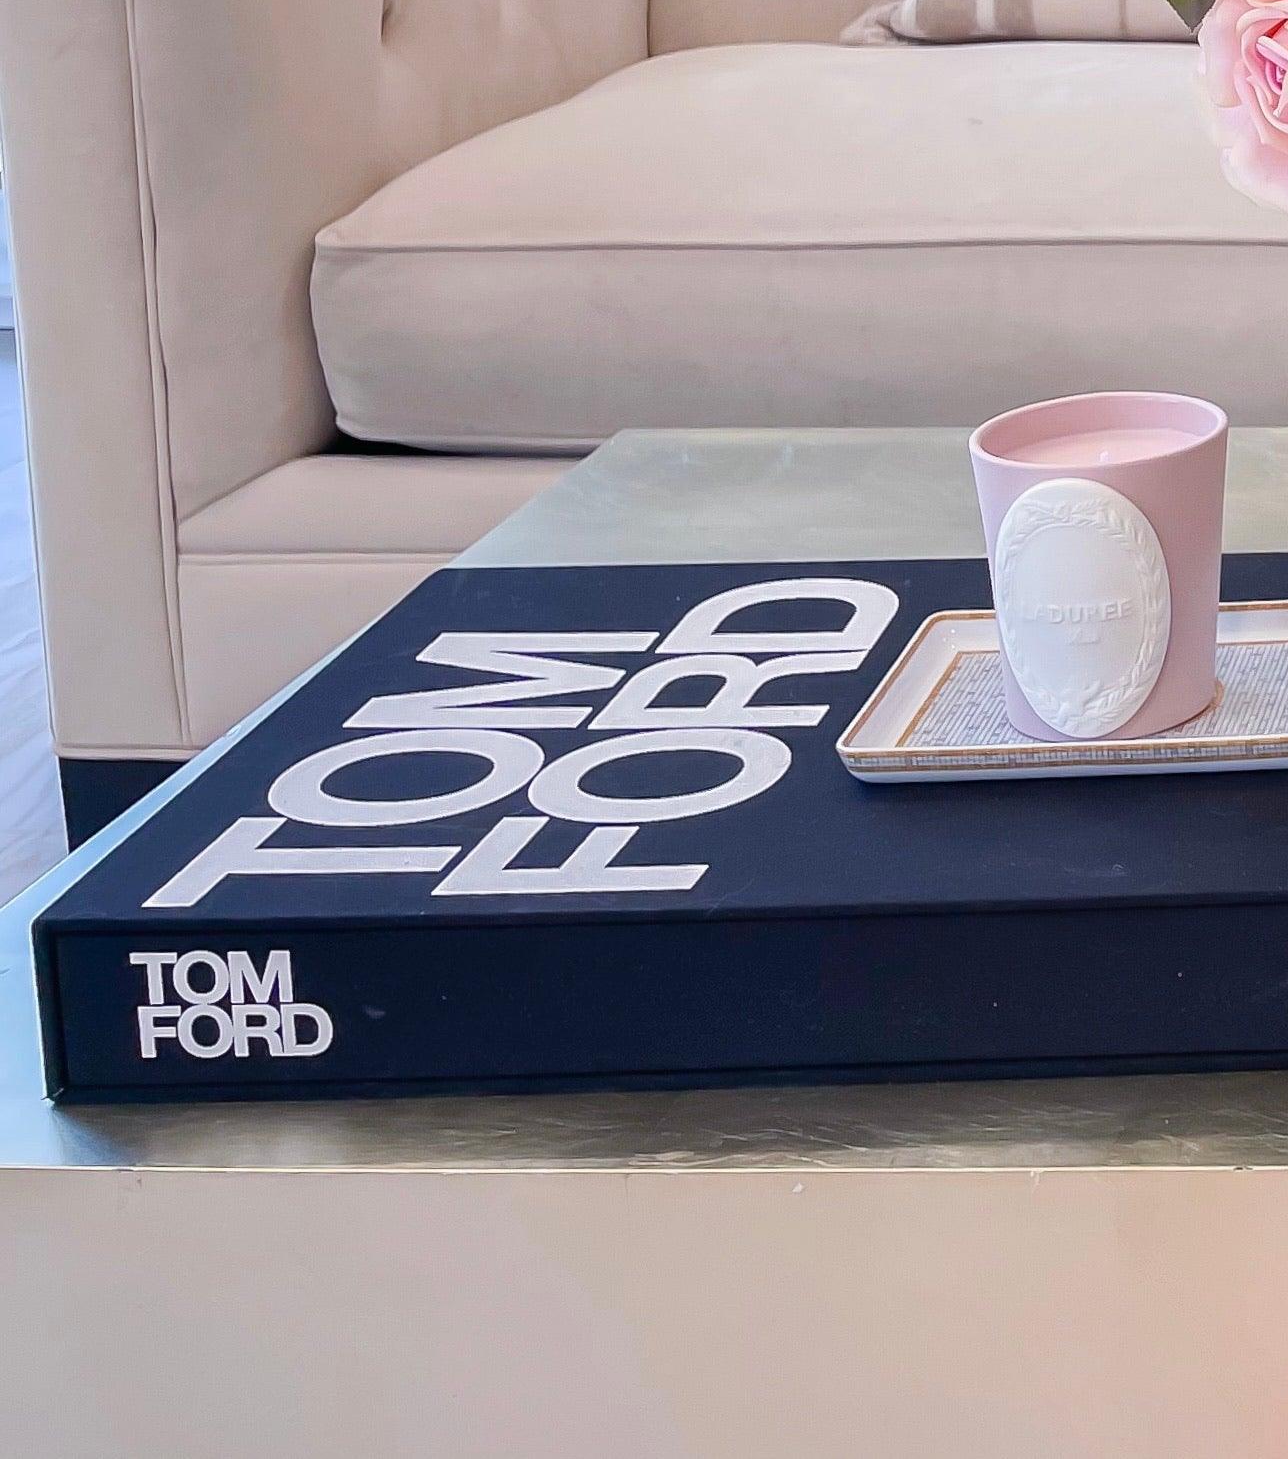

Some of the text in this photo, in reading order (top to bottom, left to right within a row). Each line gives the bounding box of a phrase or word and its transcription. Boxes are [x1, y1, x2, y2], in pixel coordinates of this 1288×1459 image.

[141, 630, 660, 908] TOM
[430, 577, 900, 896] FORD
[130, 949, 293, 1007] TOM
[138, 1004, 334, 1058] FORD
